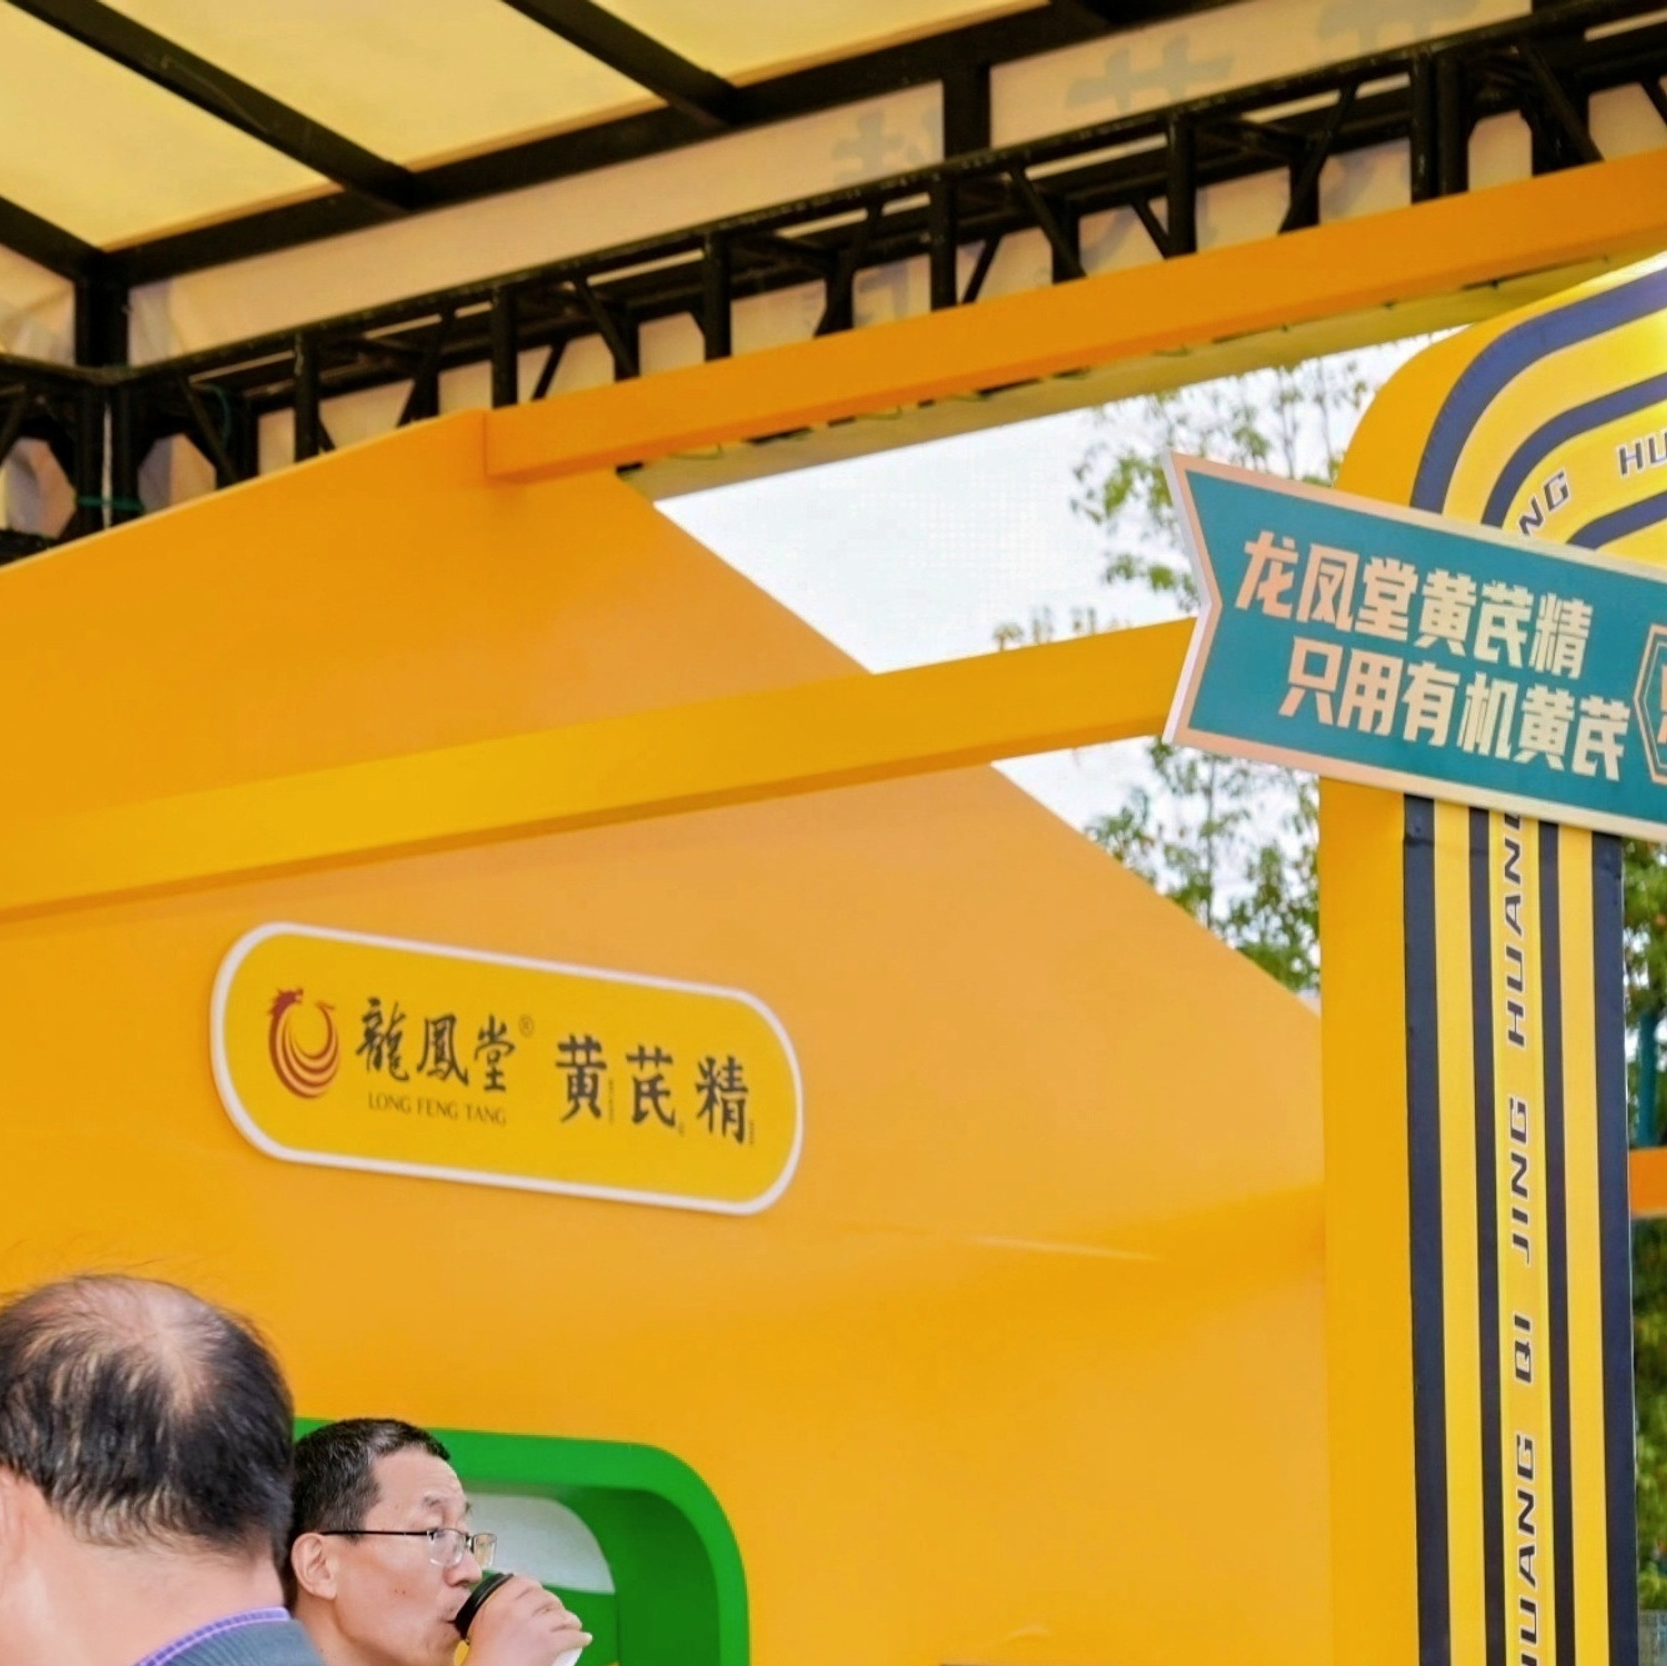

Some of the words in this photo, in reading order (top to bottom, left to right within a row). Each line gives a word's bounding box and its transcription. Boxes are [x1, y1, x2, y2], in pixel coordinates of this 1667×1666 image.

[1235, 530, 1593, 680] 龙凤堂黄芪精
[1279, 636, 1630, 781] 只用有机黄芪
[367, 1091, 412, 1116] LONG
[417, 1096, 460, 1121] FENG
[465, 1102, 507, 1127] TANG
[554, 1034, 750, 1145] 黄芪精
[1508, 1095, 1532, 1267] JING
[1512, 1312, 1535, 1385] QI
